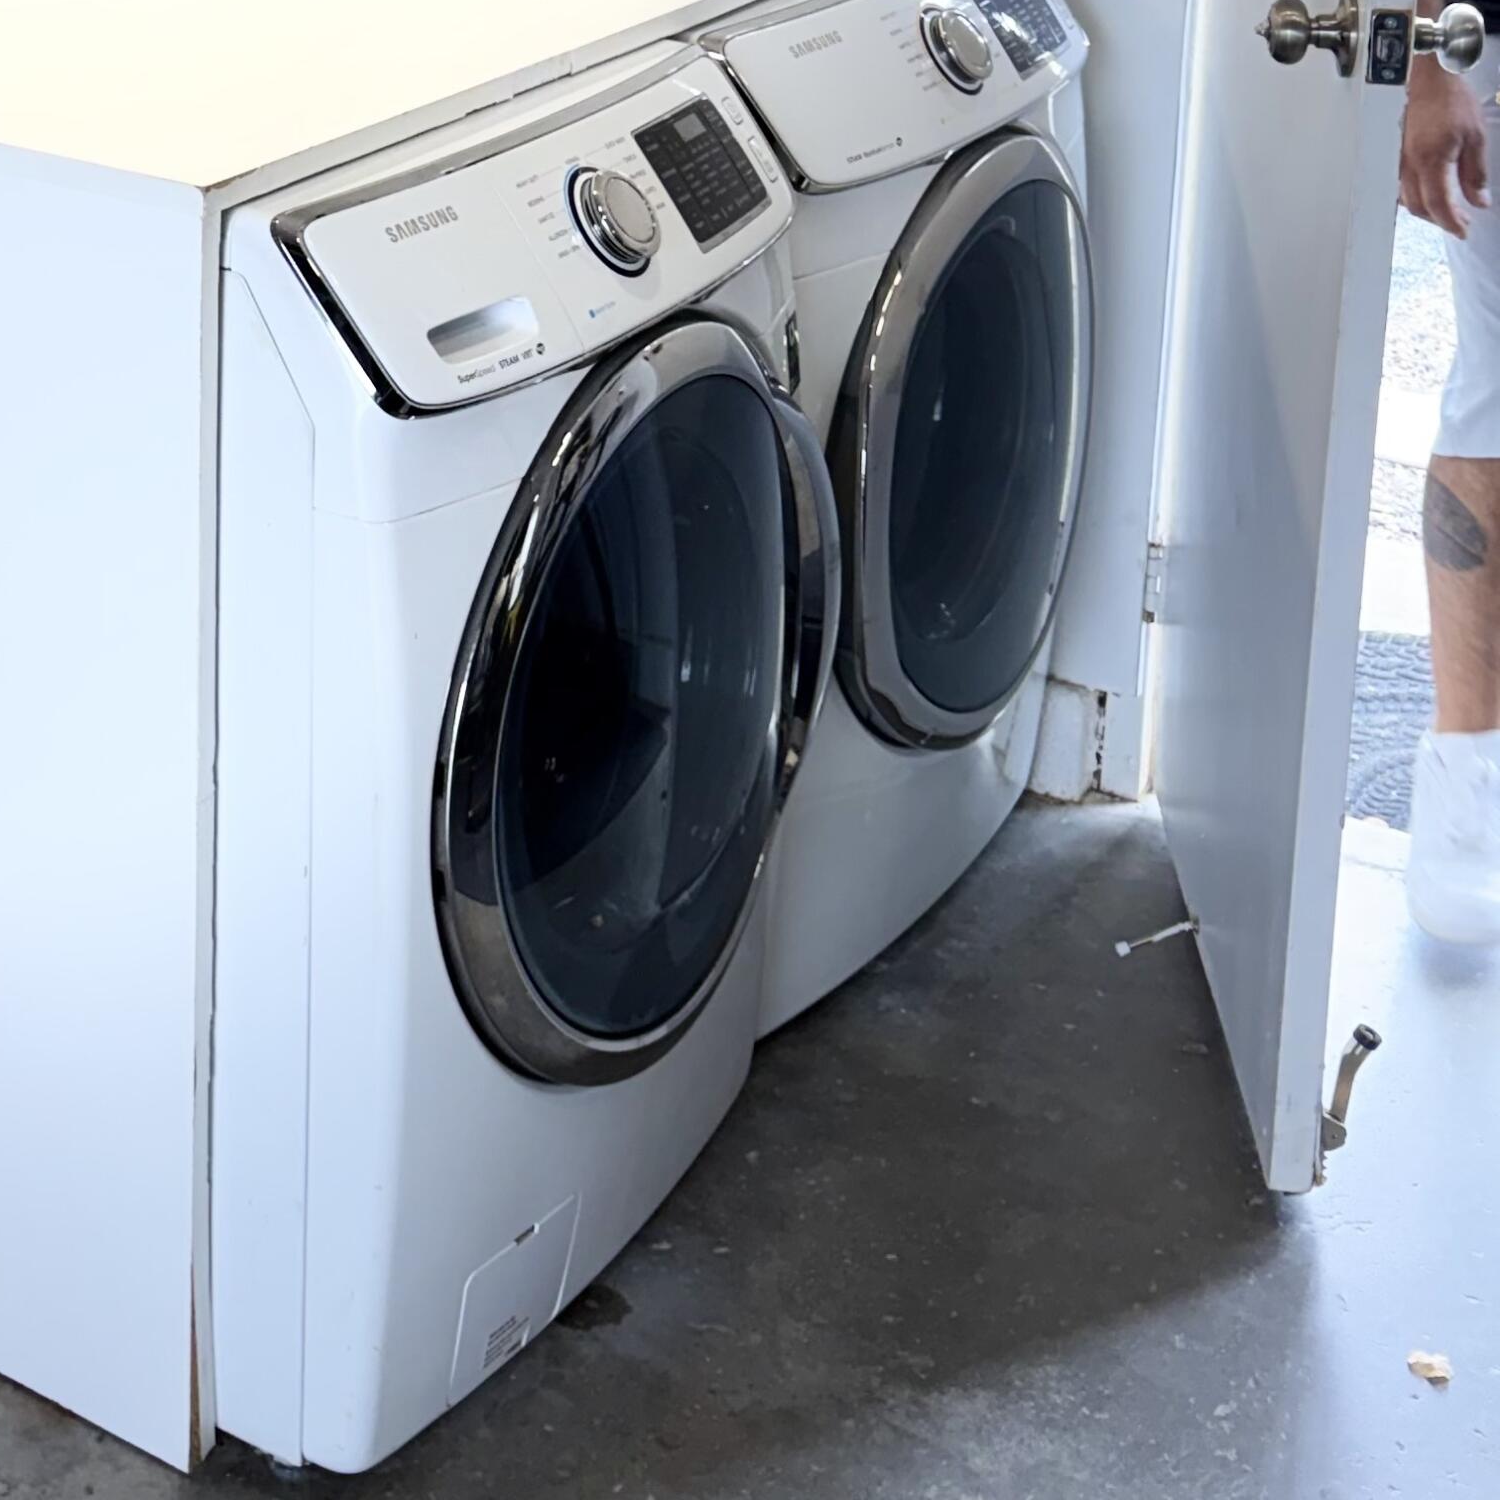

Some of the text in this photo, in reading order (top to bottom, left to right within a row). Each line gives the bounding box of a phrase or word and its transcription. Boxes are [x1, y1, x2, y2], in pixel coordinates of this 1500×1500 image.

[788, 30, 842, 59] SAMSUNG
[385, 205, 458, 243] SAMSUNG
[498, 354, 520, 369] STEAM
